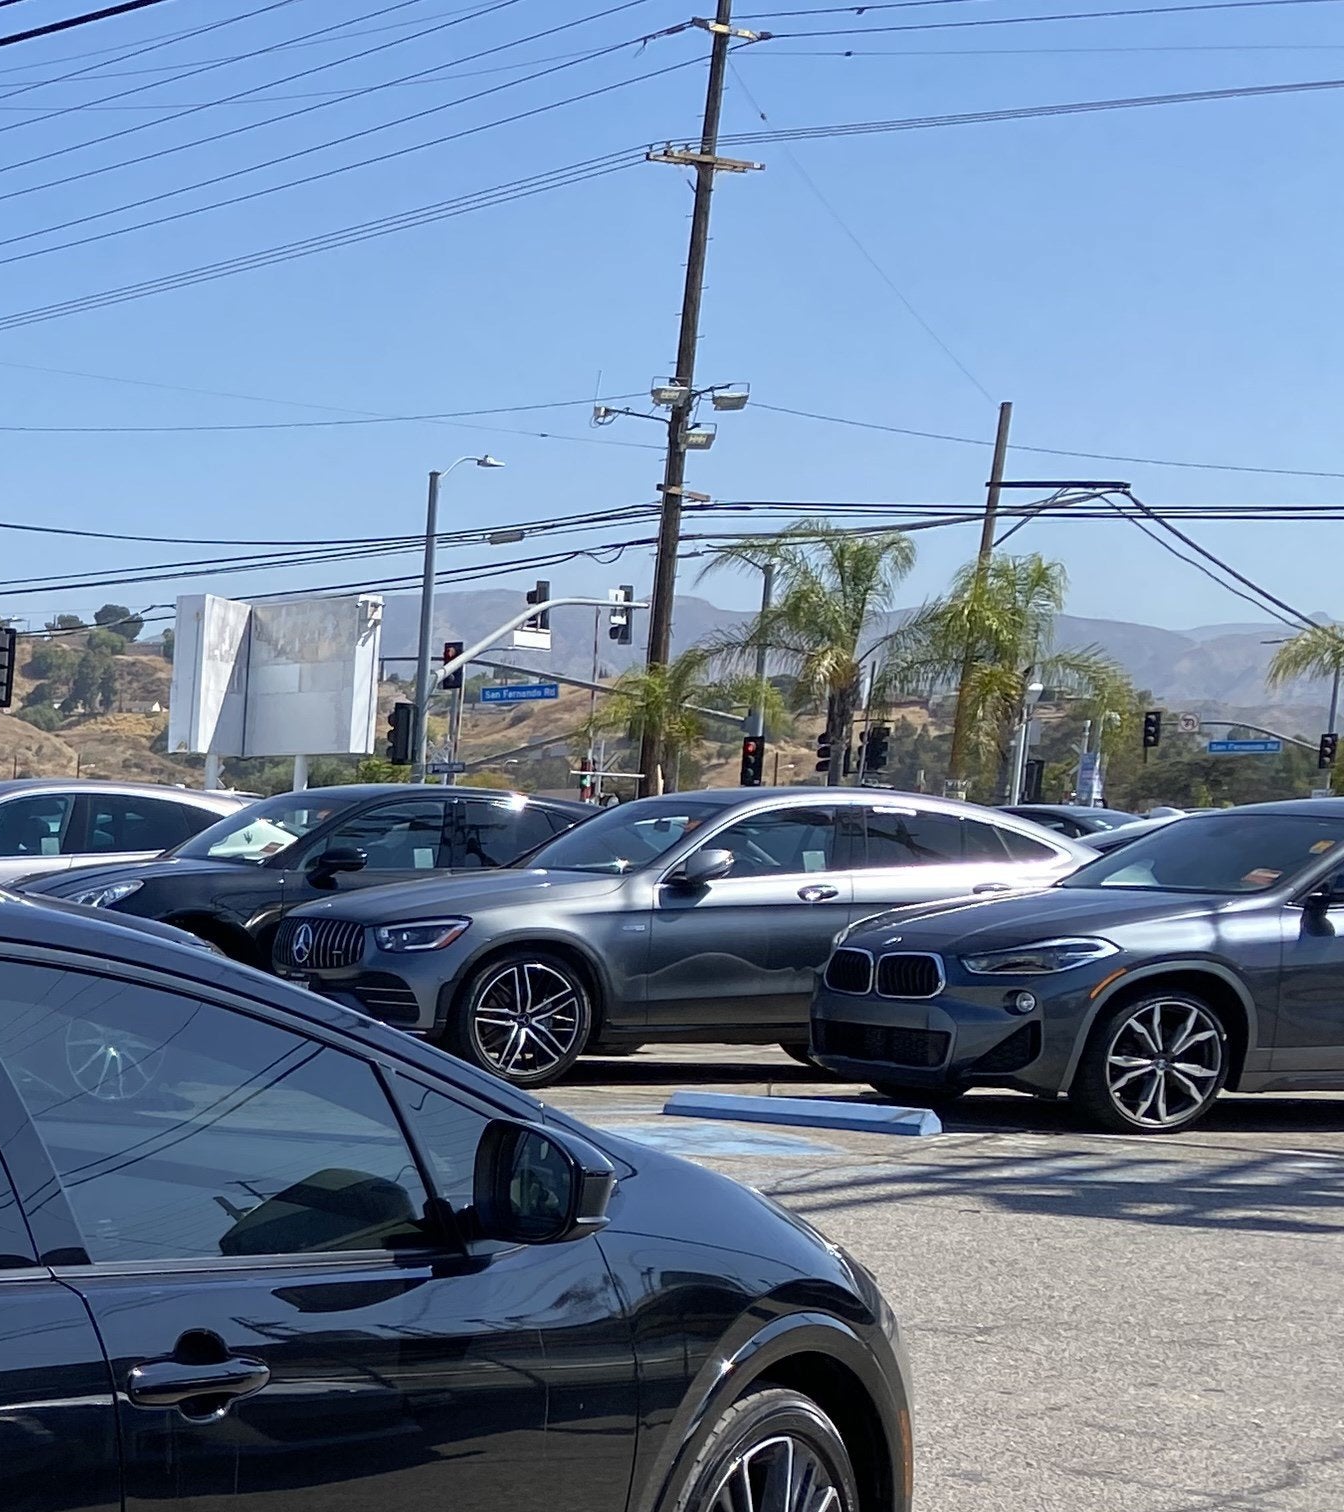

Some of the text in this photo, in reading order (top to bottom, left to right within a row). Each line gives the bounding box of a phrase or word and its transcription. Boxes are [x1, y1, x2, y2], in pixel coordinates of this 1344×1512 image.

[485, 687, 555, 699] San Fernando Rd
